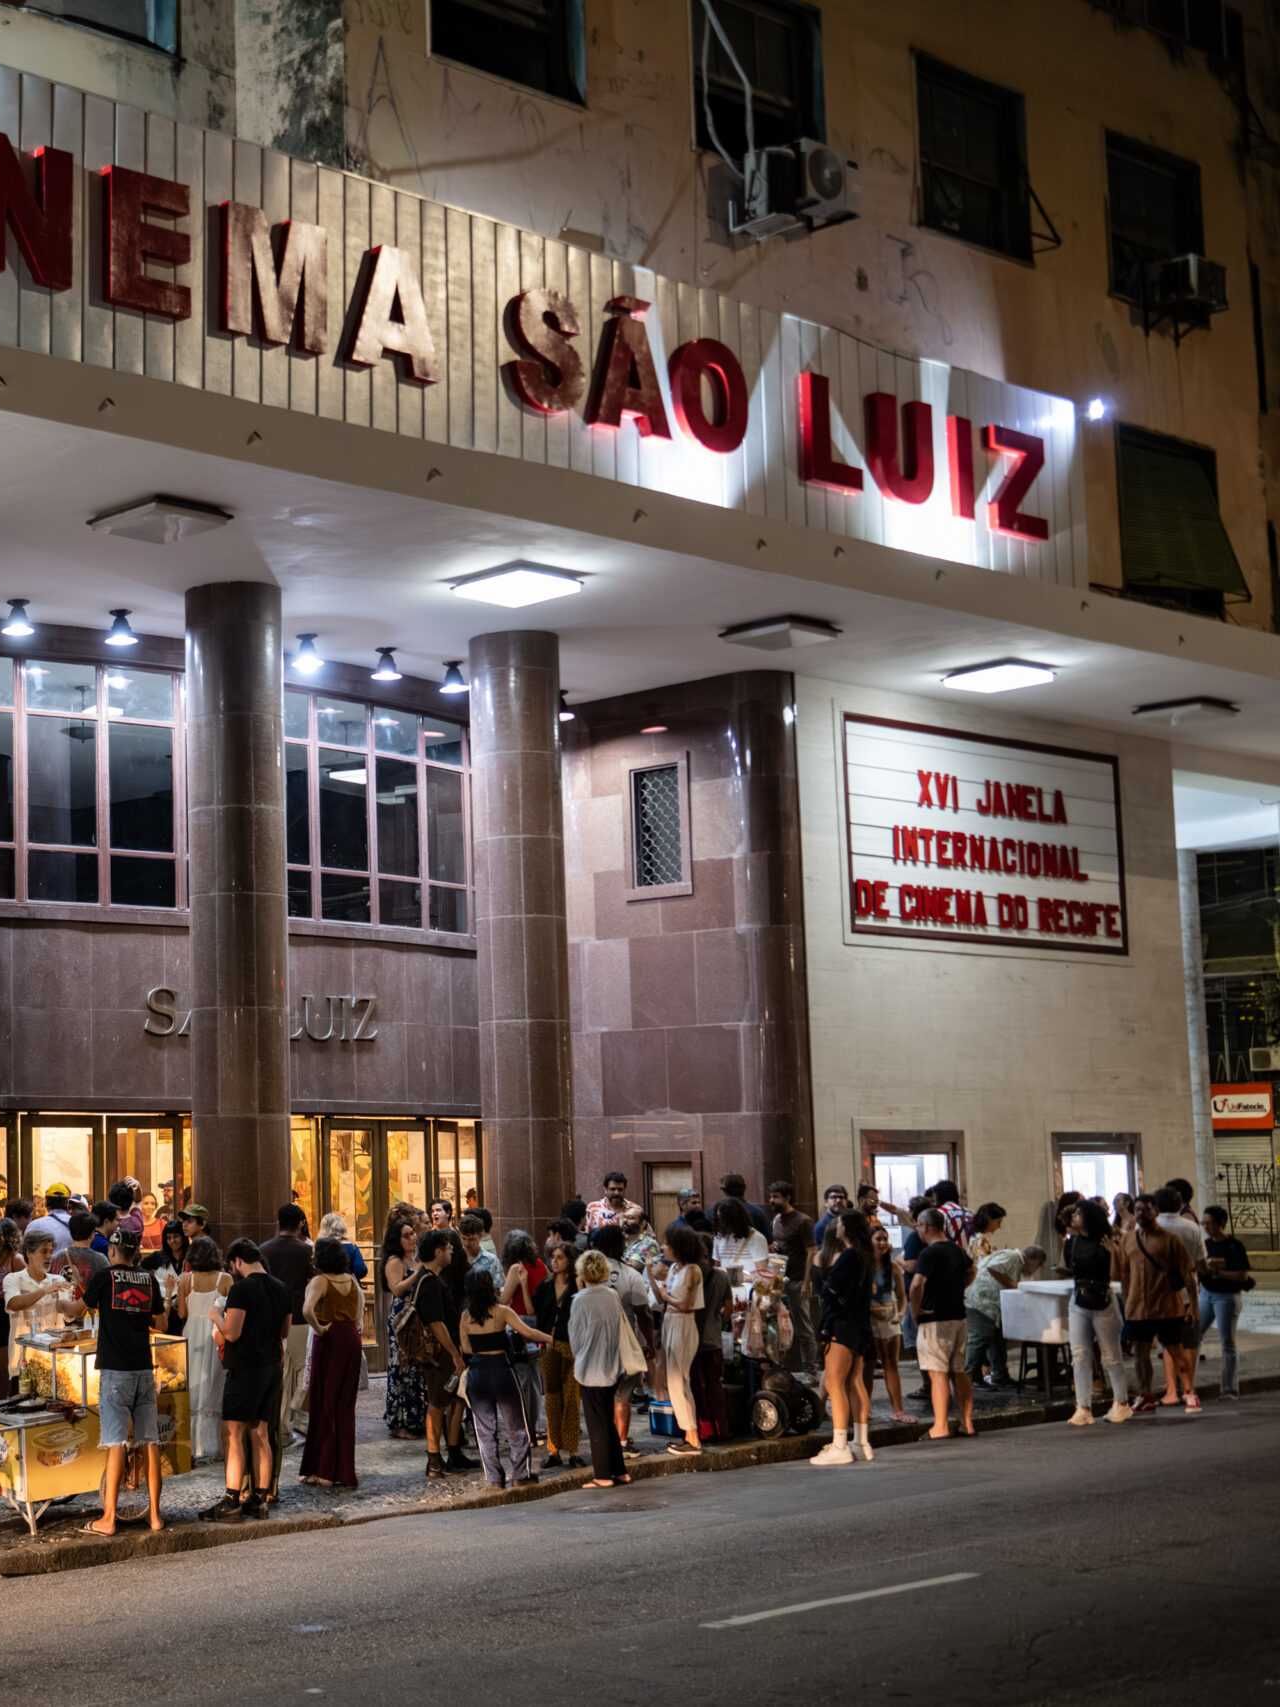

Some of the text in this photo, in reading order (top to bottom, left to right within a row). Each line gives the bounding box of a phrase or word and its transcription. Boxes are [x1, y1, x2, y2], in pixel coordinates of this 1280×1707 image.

[505, 287, 749, 455] SÃO
[795, 371, 1049, 543] LUIZ
[917, 768, 1068, 825] XVI JANELA
[892, 824, 1088, 882] INTERNACIONAL
[856, 878, 1120, 938] DE CINEMA DO RECIFE
[289, 994, 378, 1042] UIZ
[114, 1271, 151, 1285] SEAWAY
